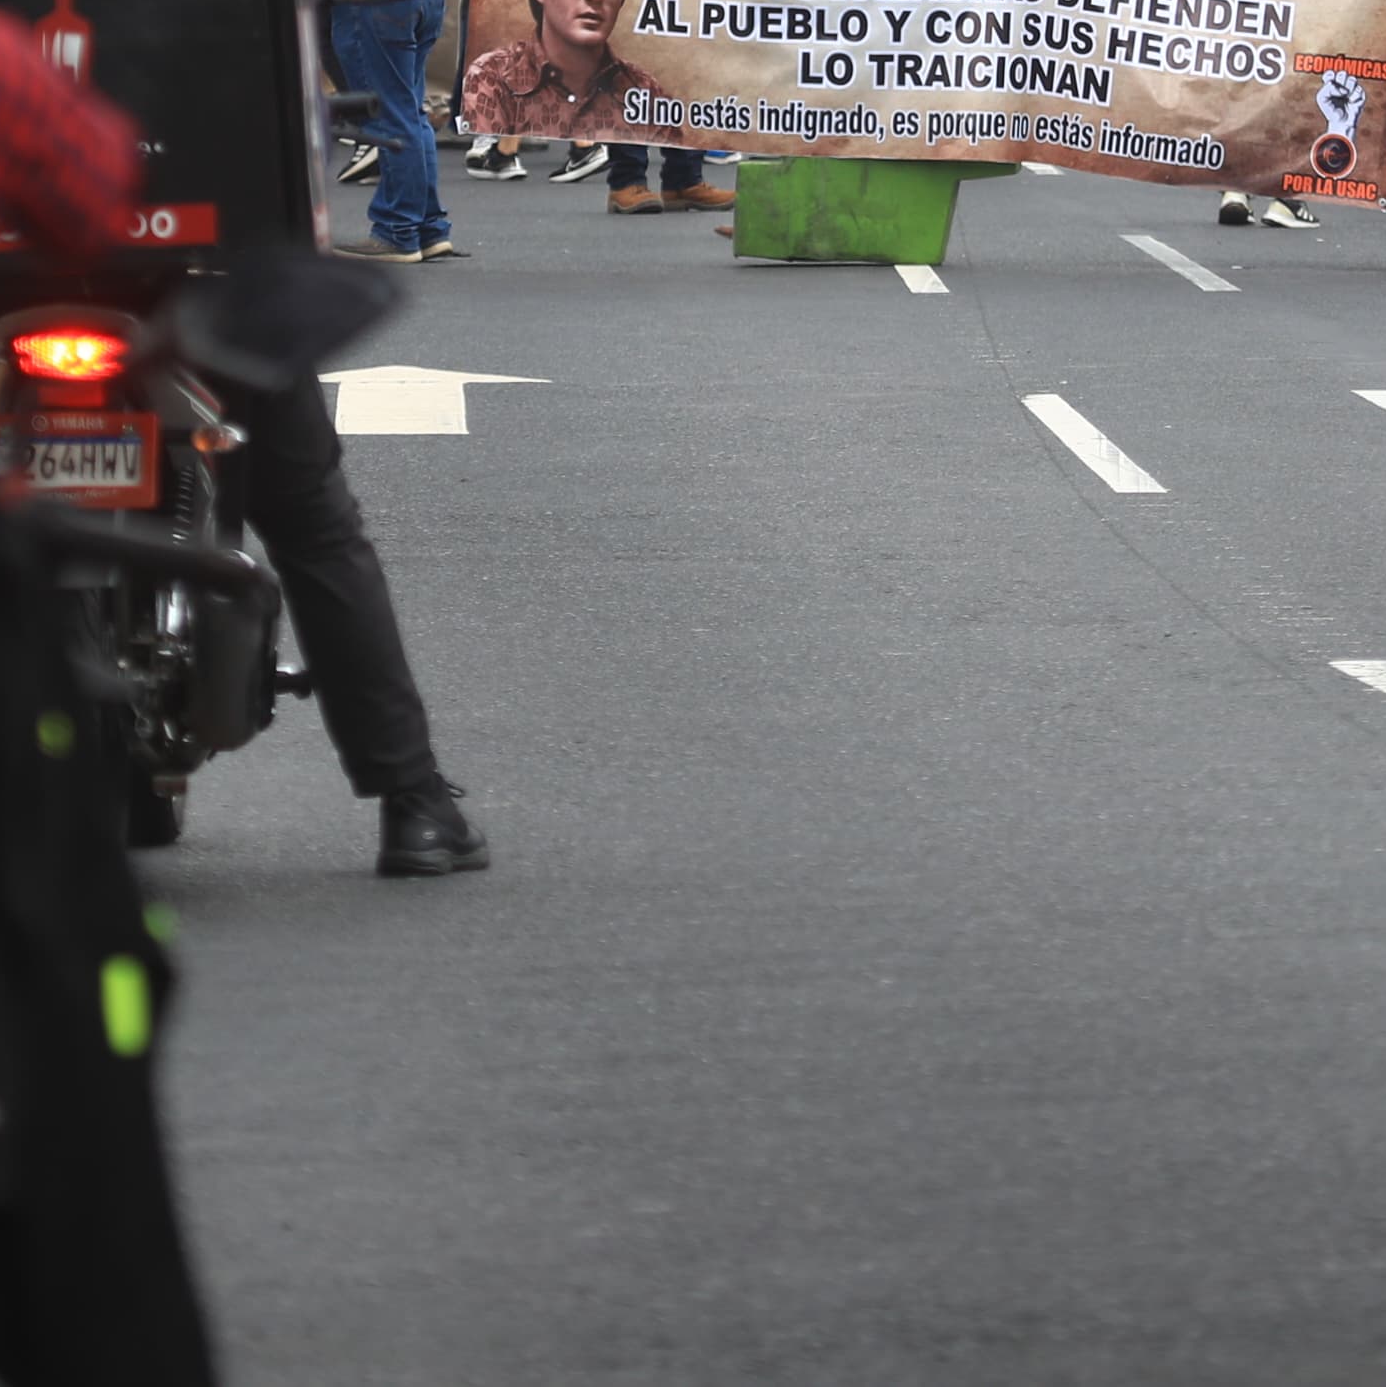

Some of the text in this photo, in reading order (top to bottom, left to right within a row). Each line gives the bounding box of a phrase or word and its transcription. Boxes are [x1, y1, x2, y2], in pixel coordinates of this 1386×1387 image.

[637, 0, 1286, 82] AL PUEBLO Y CON SUS HECHOS
[799, 52, 1111, 104] LO TRAICIONAN
[624, 90, 1225, 170] Si no estás indignado, es porque no estás informado
[1283, 174, 1378, 201] POR LA USAC
